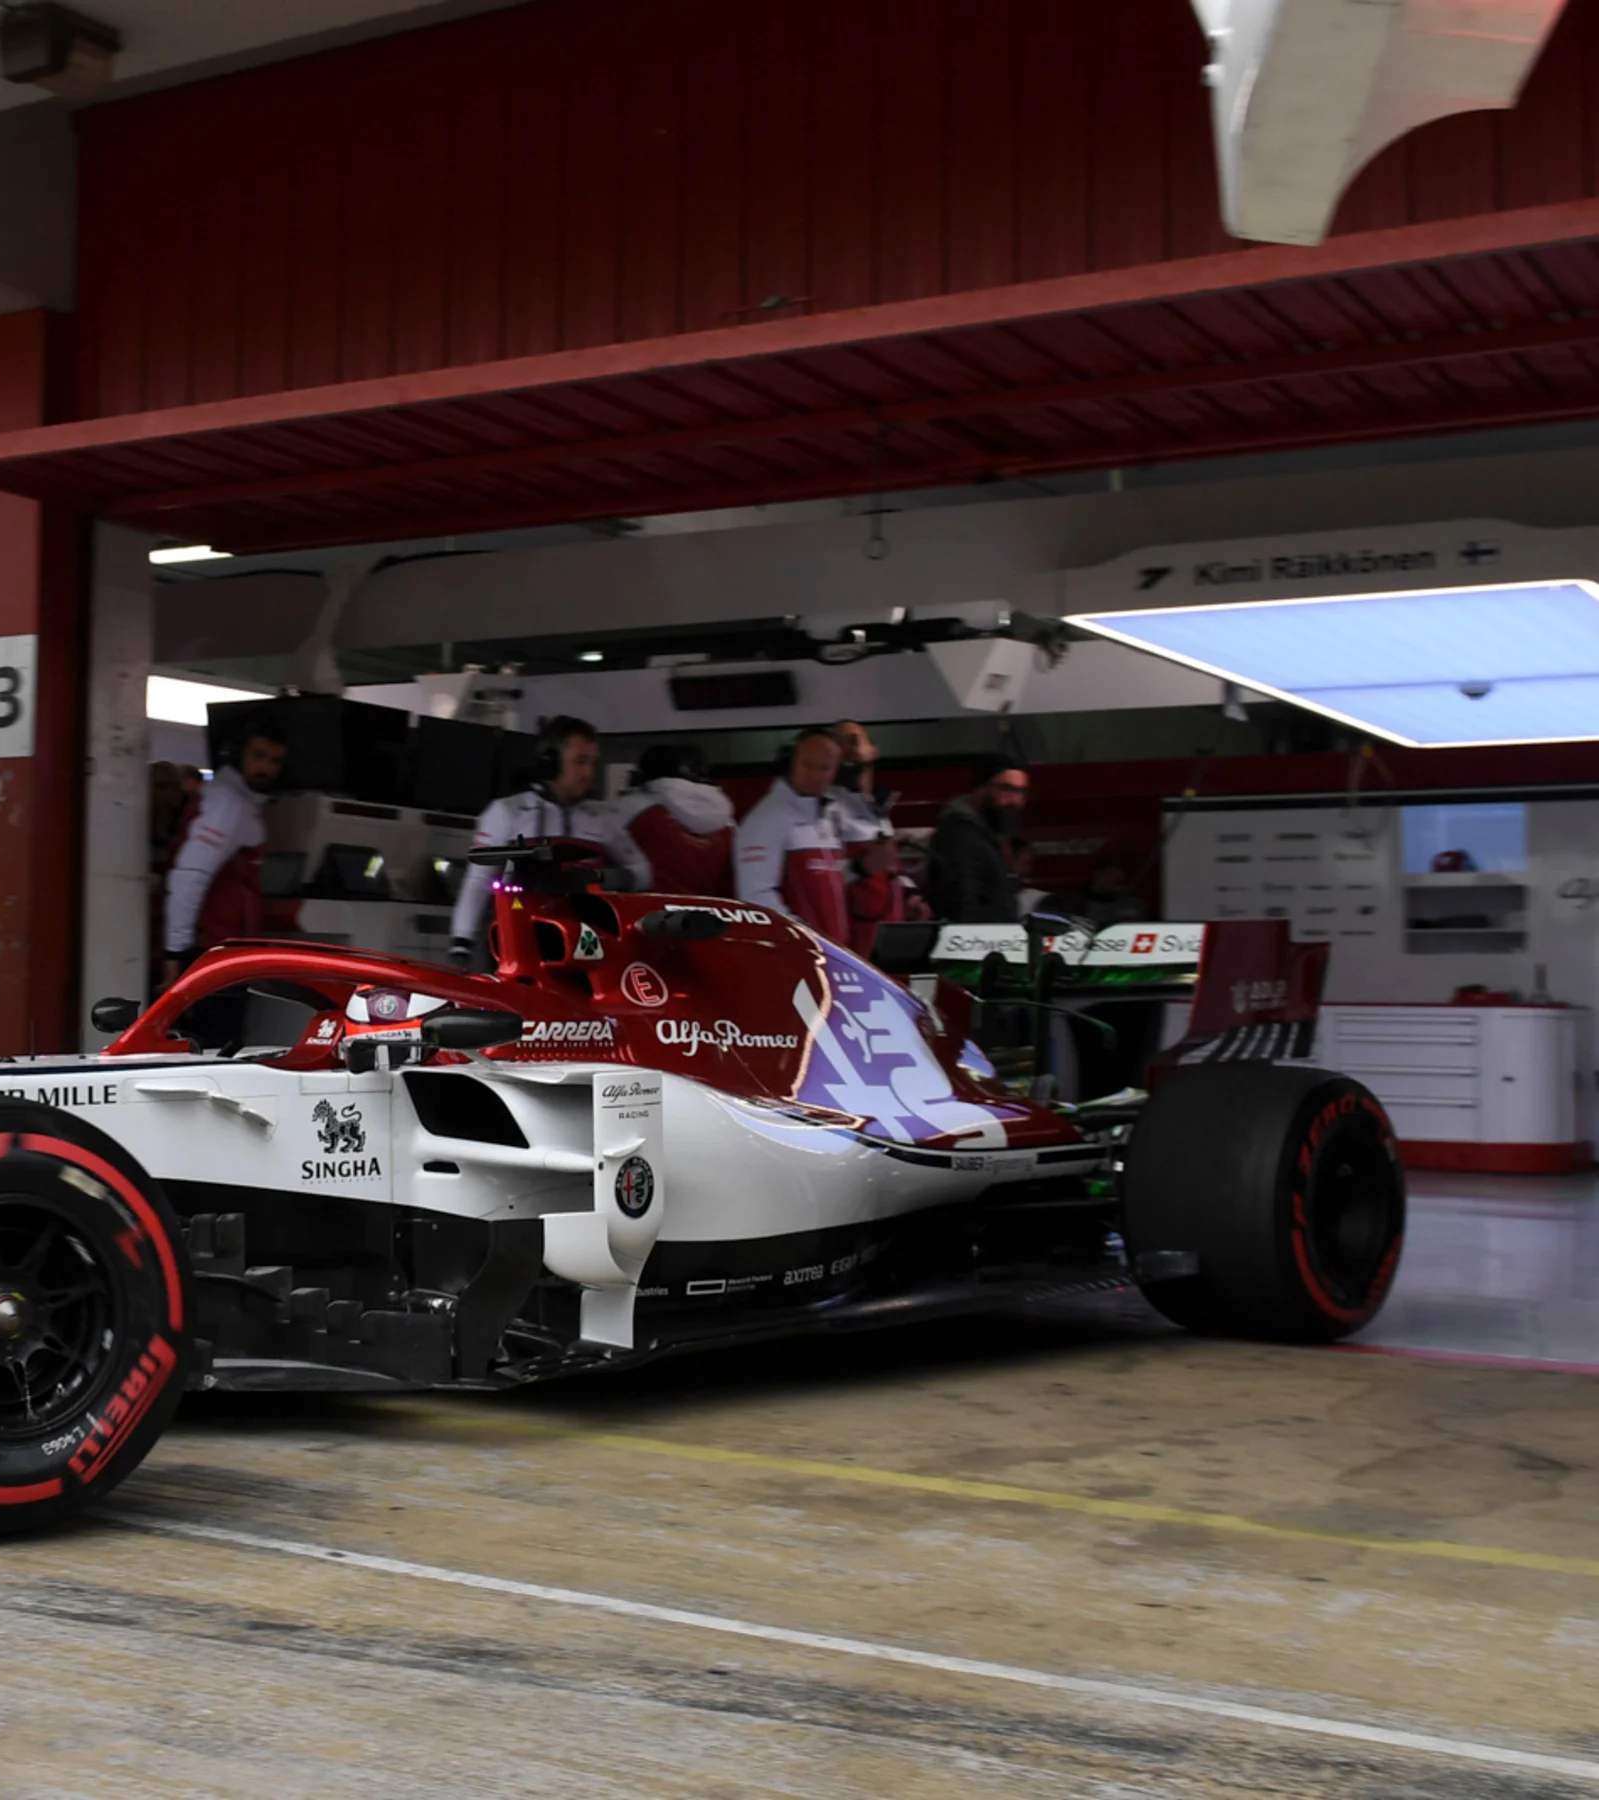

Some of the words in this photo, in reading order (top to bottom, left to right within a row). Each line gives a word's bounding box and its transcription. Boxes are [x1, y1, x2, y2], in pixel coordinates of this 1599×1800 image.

[1136, 566, 1174, 591] 7
[1194, 557, 1263, 586] Kimi
[1271, 548, 1436, 582] Räikkönen
[946, 934, 1029, 953] Schweiz
[1059, 934, 1128, 953] Susse
[520, 1020, 614, 1042] CARRERA
[656, 1019, 716, 1056] Alfa
[714, 1019, 799, 1050] Romeo
[37, 1084, 118, 1107] MILLE
[601, 1084, 628, 1104] Alfa
[628, 1081, 660, 1097] Romeo
[618, 1109, 650, 1120] RACING
[301, 1156, 381, 1180] SINGHA
[68, 1333, 177, 1486] PIRELLI
